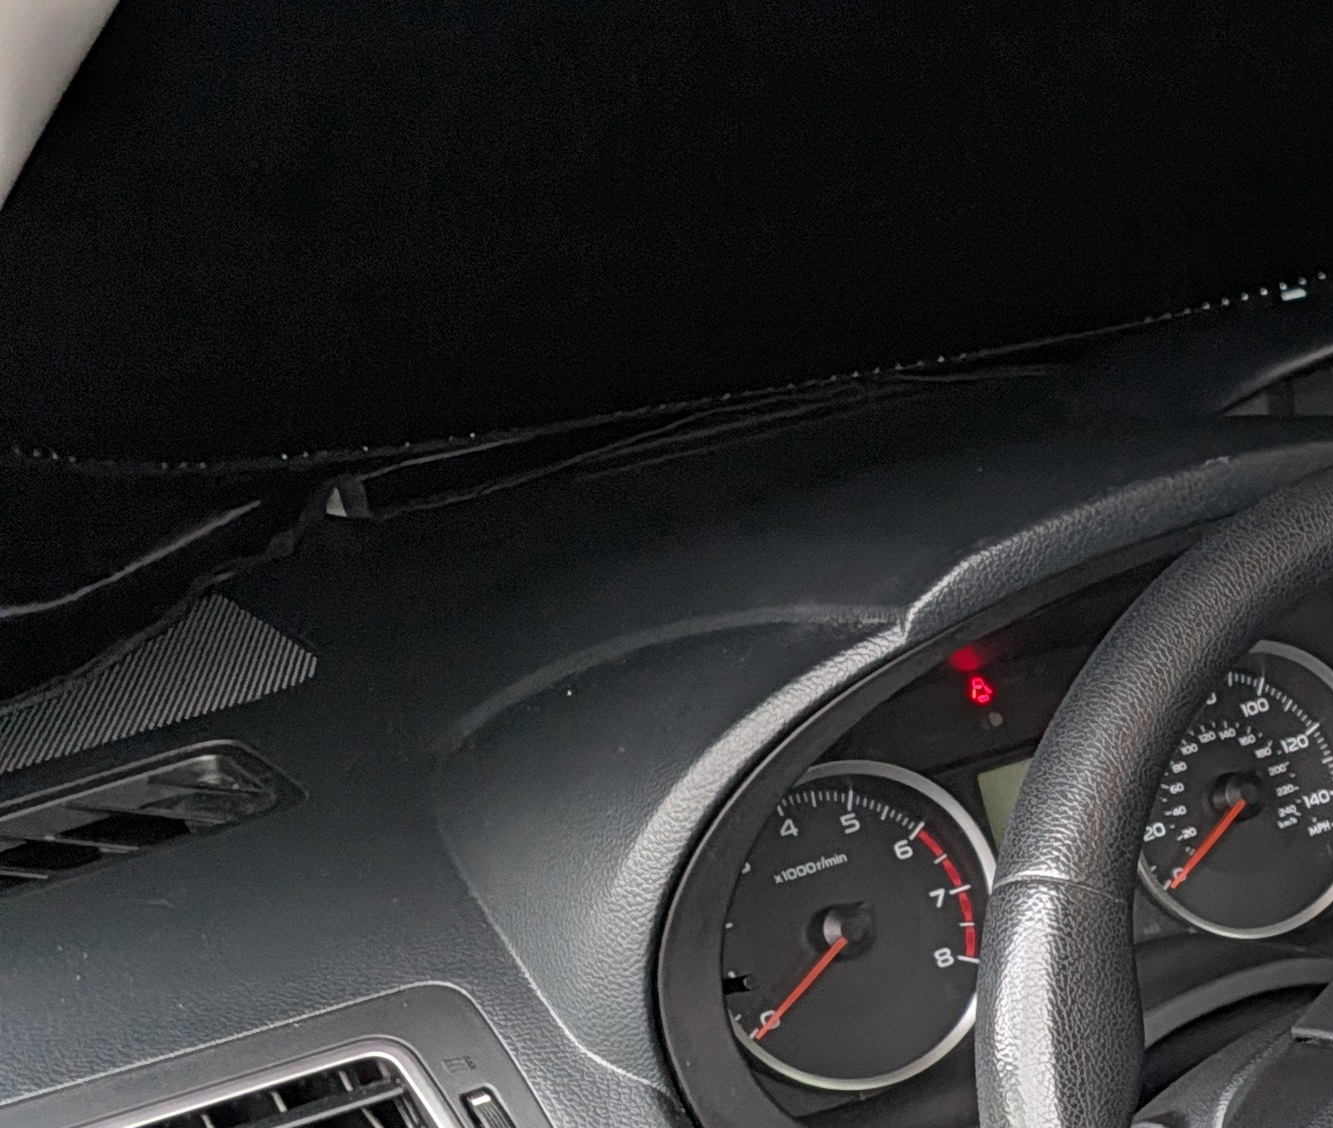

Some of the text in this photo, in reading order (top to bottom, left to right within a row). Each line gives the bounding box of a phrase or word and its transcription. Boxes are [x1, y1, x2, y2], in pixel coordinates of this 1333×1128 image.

[1240, 698, 1270, 718] 100
[1199, 731, 1216, 743] 120
[1218, 728, 1236, 740] 140
[1180, 743, 1198, 755] 100
[1280, 734, 1309, 754] 120
[1255, 746, 1272, 758] 180
[1172, 761, 1187, 773] 80
[1268, 765, 1286, 776] 200
[1169, 782, 1184, 794] 60
[1276, 784, 1294, 796] 220
[1302, 790, 1330, 810] 140
[1172, 805, 1187, 816] 40
[1278, 804, 1297, 817] 240
[779, 818, 799, 838] 4
[840, 813, 861, 834] 5
[1308, 821, 1331, 837] MPH
[1143, 822, 1166, 842] 20
[1182, 827, 1197, 839] 20
[894, 839, 913, 860] 6
[929, 888, 945, 908] 7
[933, 947, 955, 968] 8
